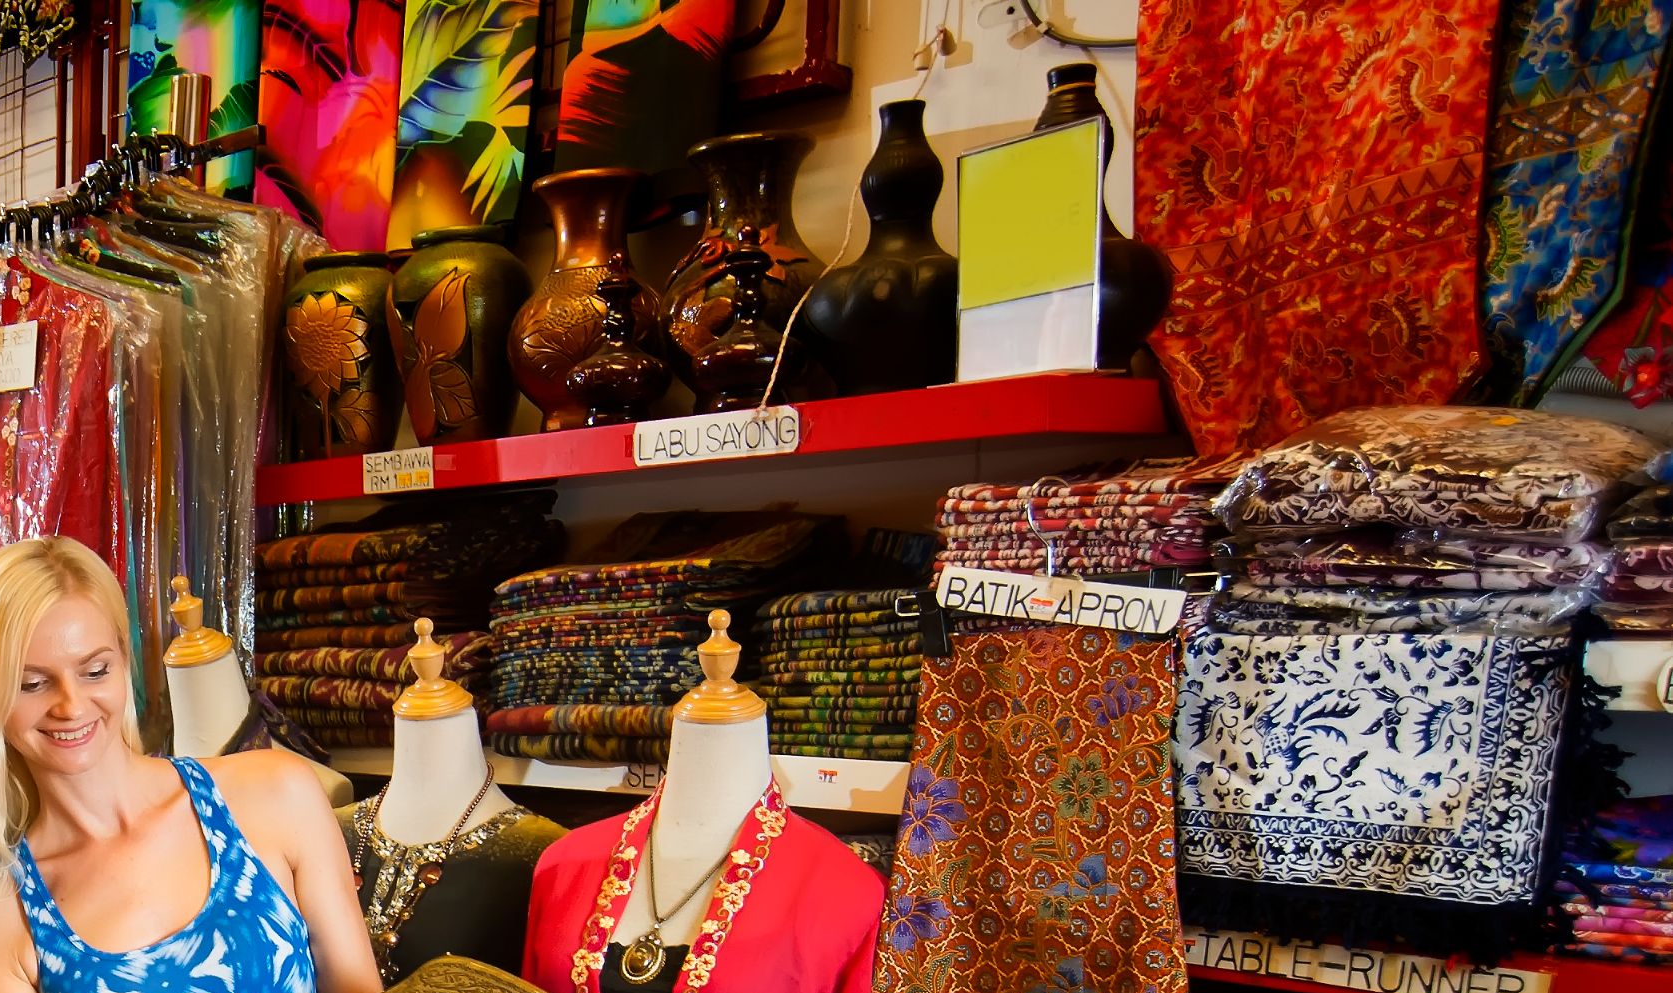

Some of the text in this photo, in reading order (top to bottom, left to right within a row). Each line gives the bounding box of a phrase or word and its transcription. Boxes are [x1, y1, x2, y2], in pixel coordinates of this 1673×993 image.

[638, 415, 797, 461] LABU SAYONG
[365, 452, 431, 473] SEMBAWA
[945, 576, 1167, 633] BATIK APRON
